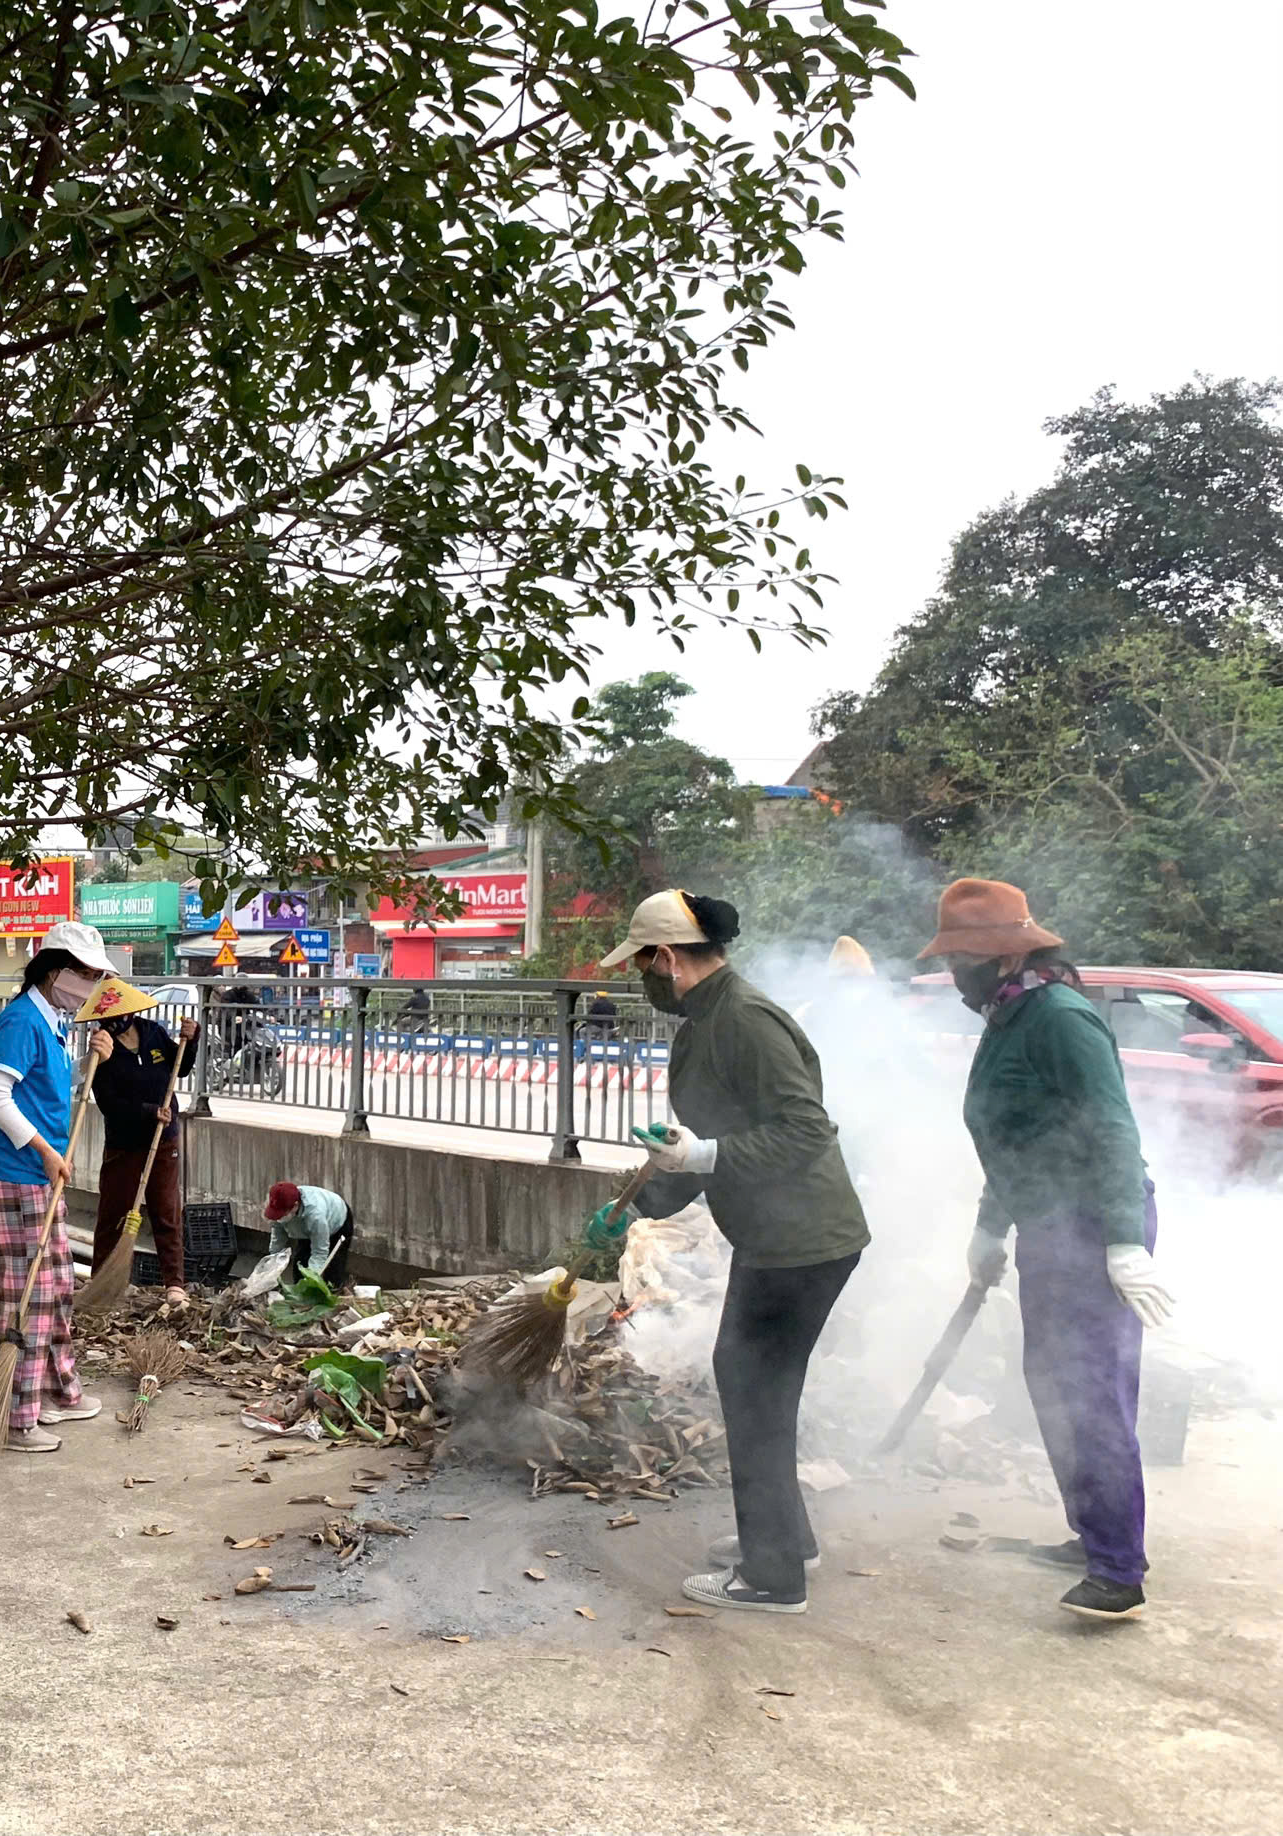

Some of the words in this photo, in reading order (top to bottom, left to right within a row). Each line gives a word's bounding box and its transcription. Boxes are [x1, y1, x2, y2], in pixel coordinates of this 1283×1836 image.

[20, 900, 40, 912] NEW
[83, 896, 98, 915] NHÀ
[98, 892, 120, 915] THUỐC
